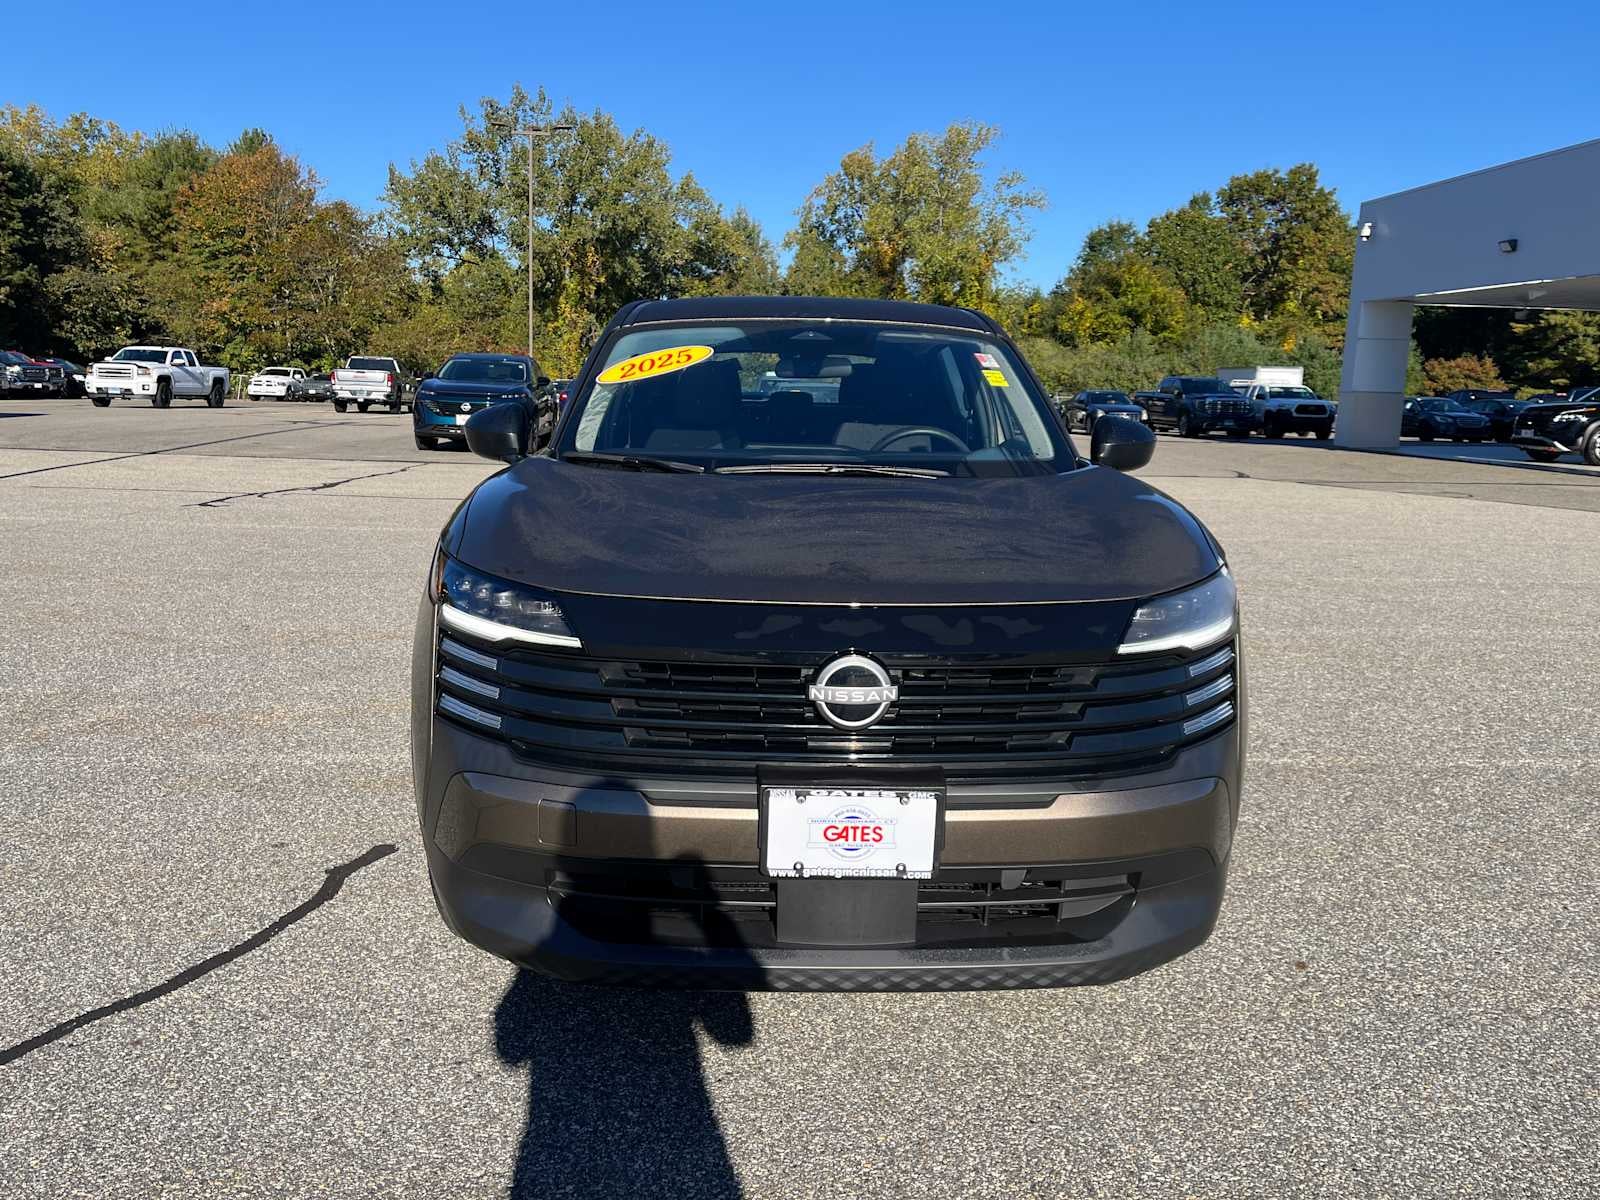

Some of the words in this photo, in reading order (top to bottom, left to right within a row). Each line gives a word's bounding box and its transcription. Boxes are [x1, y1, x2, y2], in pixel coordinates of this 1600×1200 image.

[620, 349, 692, 378] 2025
[811, 688, 896, 702] NISSAN
[823, 825, 884, 843] GATES
